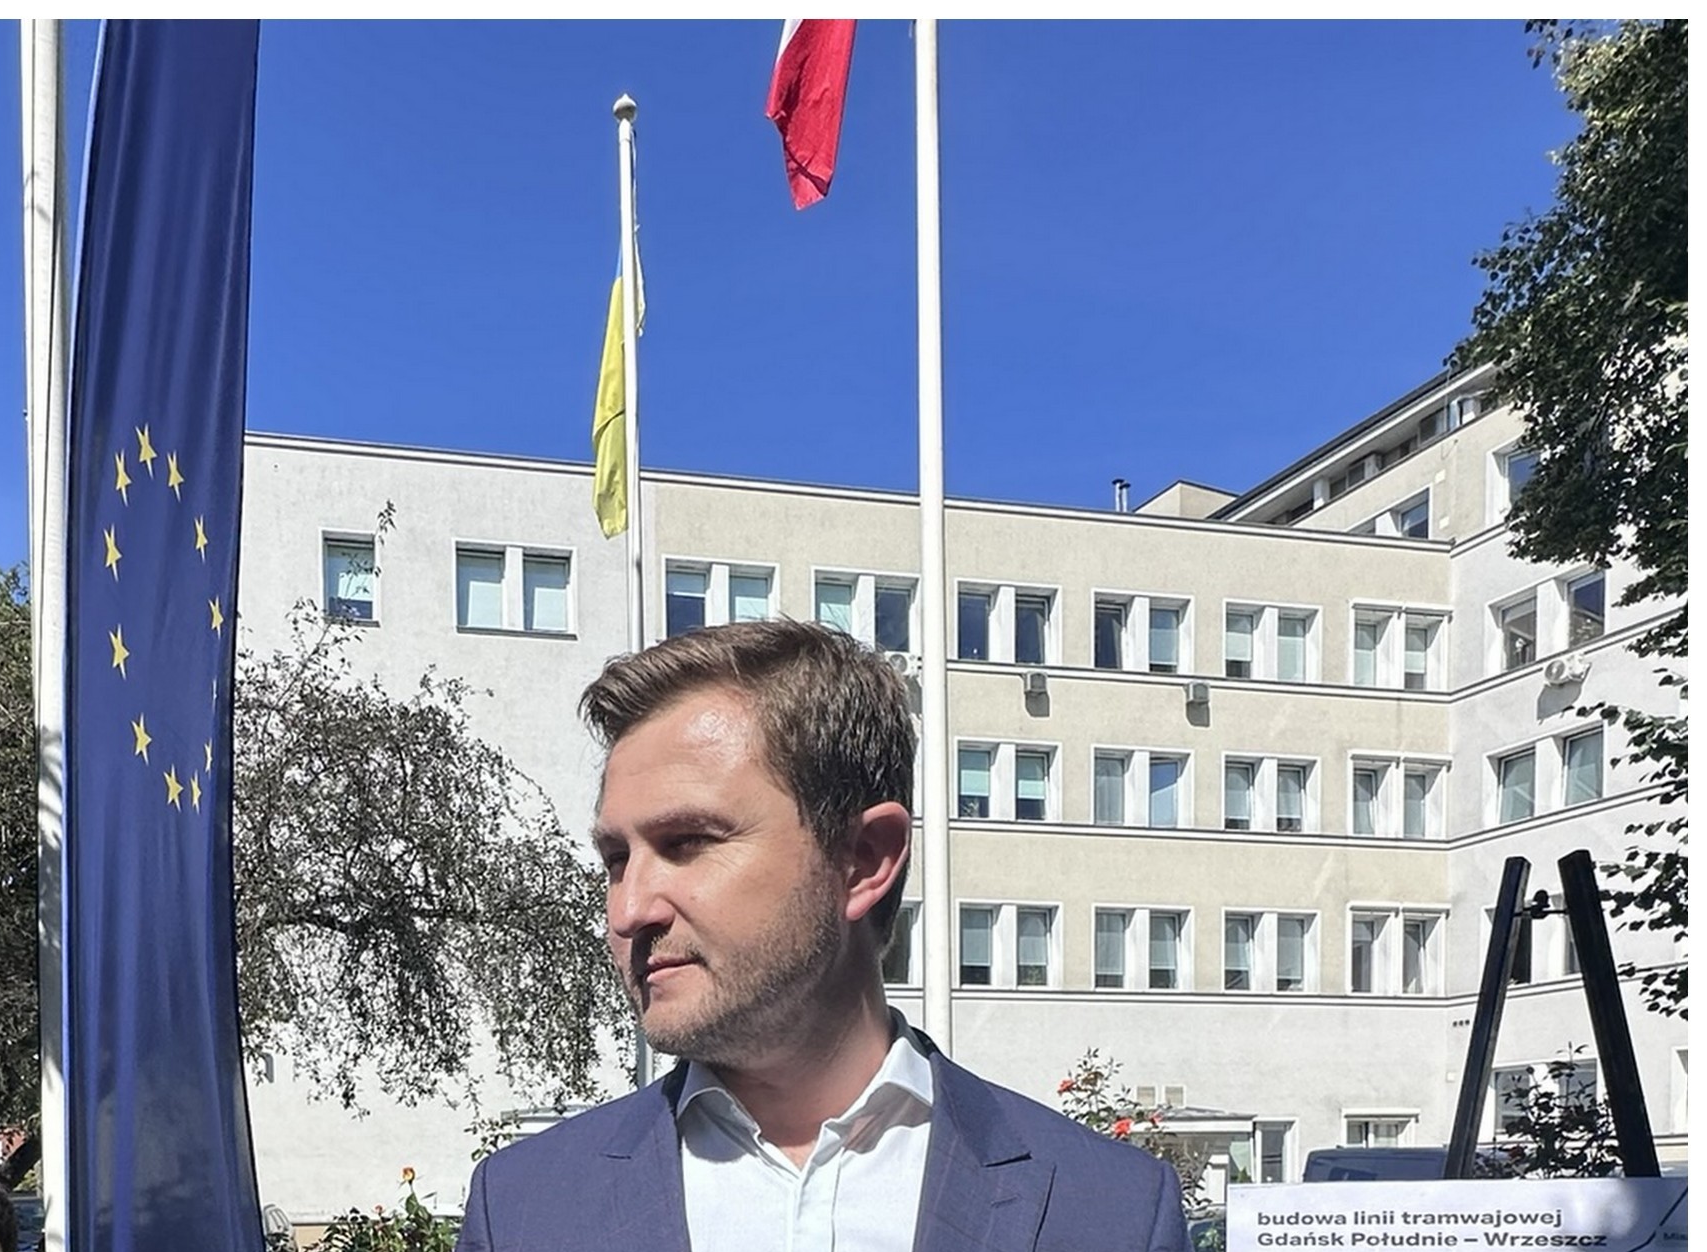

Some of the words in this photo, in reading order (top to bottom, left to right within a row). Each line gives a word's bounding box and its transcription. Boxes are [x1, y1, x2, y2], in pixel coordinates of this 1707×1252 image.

[1257, 1211, 1347, 1225] budowa
[1354, 1210, 1395, 1225] linii
[1401, 1209, 1562, 1228] tramwajowej
[1257, 1231, 1344, 1246] Gdańsk
[1351, 1232, 1458, 1247] Południe
[1484, 1231, 1608, 1247] Wrzeszcz
